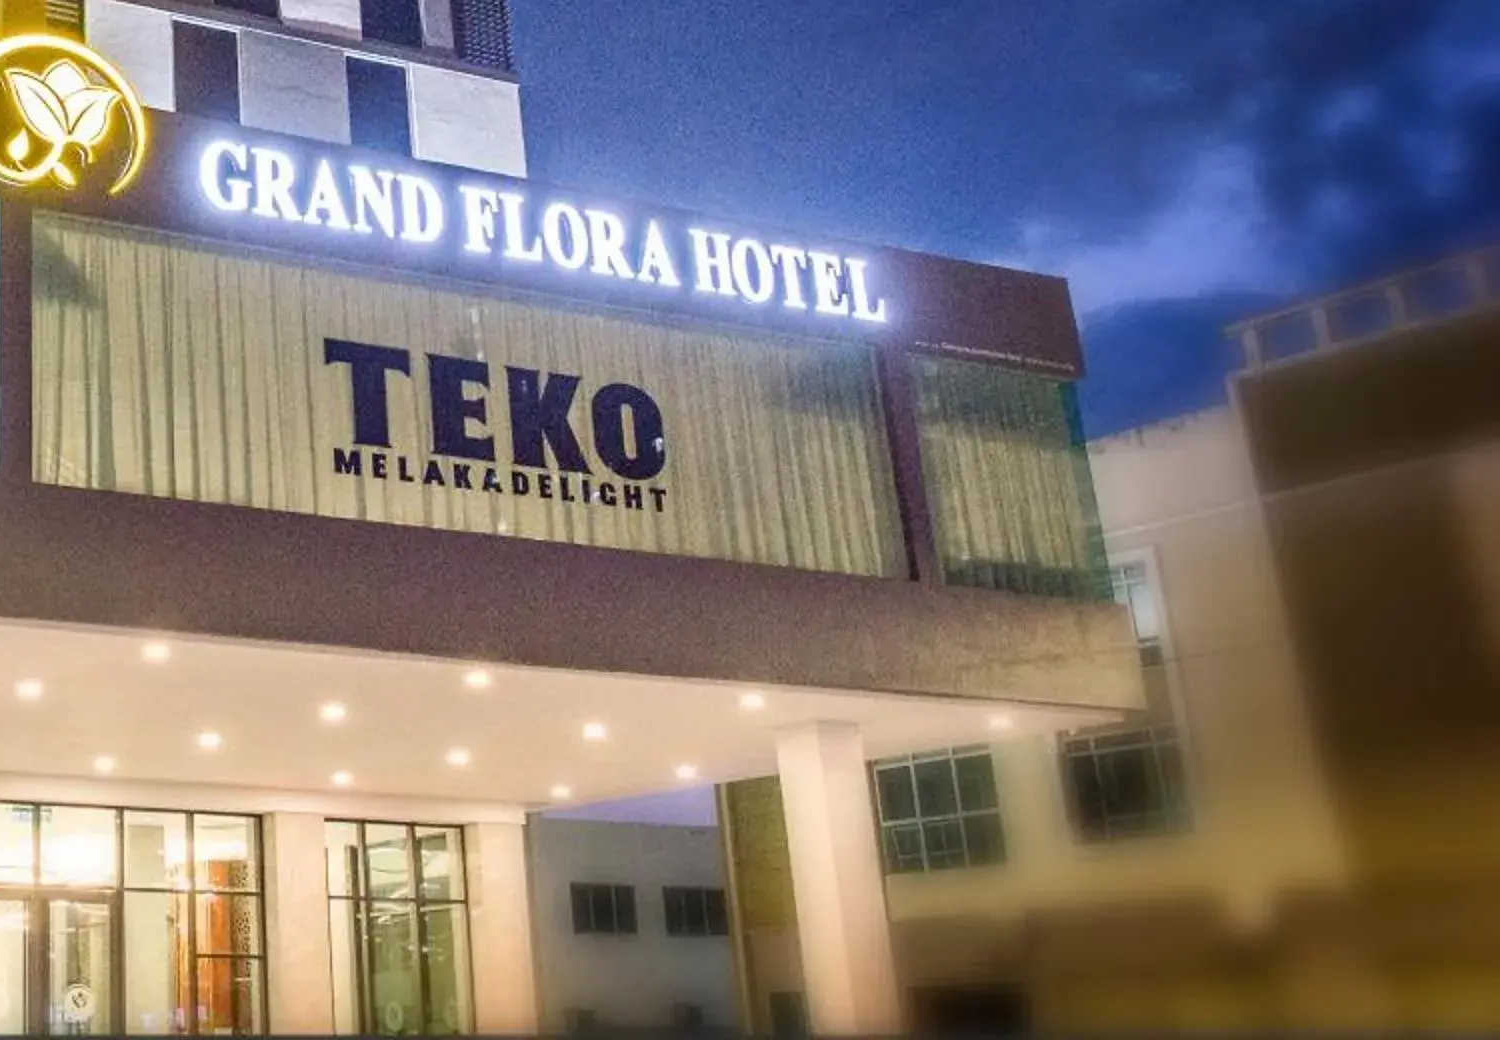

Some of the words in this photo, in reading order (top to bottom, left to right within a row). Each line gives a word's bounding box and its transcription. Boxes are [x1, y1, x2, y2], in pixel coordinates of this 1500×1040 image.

[200, 140, 443, 244] GRAND
[460, 183, 679, 289] FLORA
[688, 226, 887, 324] HOTEL
[324, 337, 666, 480] TEKO
